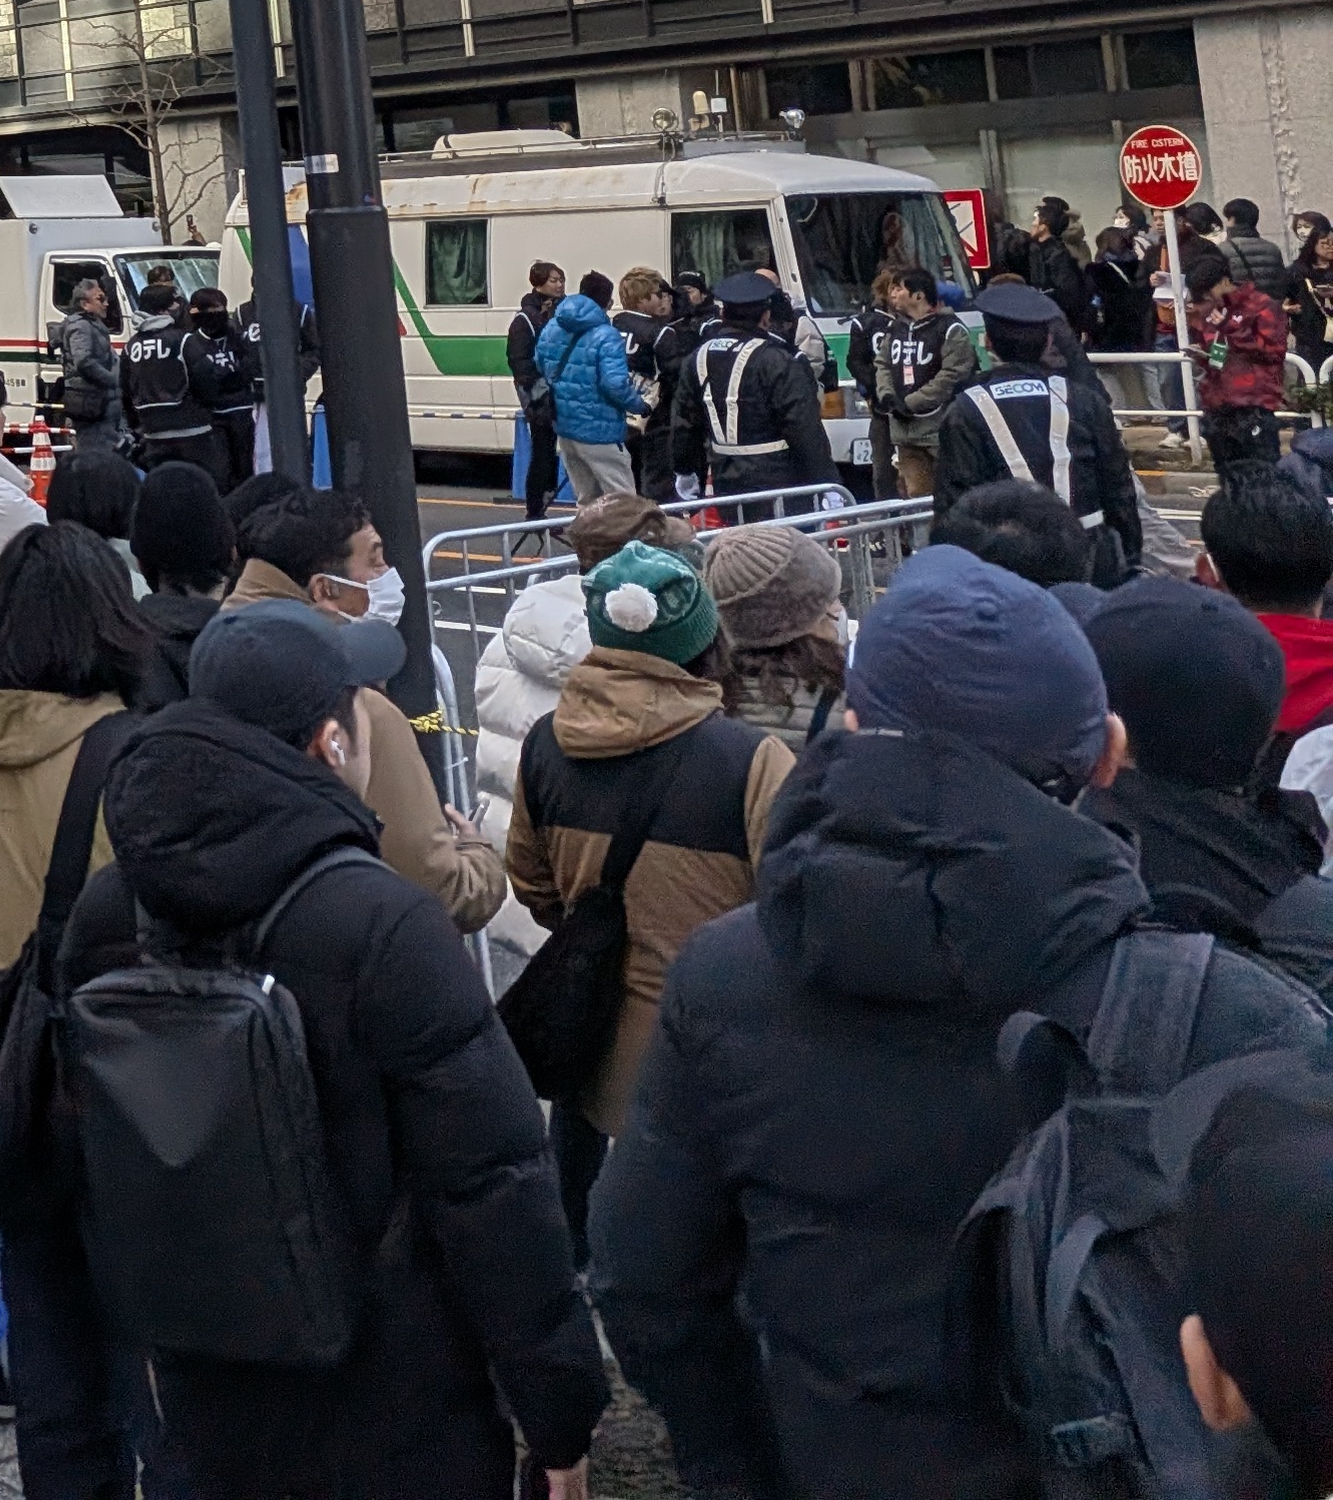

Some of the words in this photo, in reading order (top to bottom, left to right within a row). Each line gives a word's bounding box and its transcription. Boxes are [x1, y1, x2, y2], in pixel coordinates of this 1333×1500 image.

[1131, 139, 1149, 149] FIRE
[1151, 137, 1184, 148] CISTERN
[1123, 151, 1200, 184] 防火水槽
[994, 382, 1045, 396] SECOM
